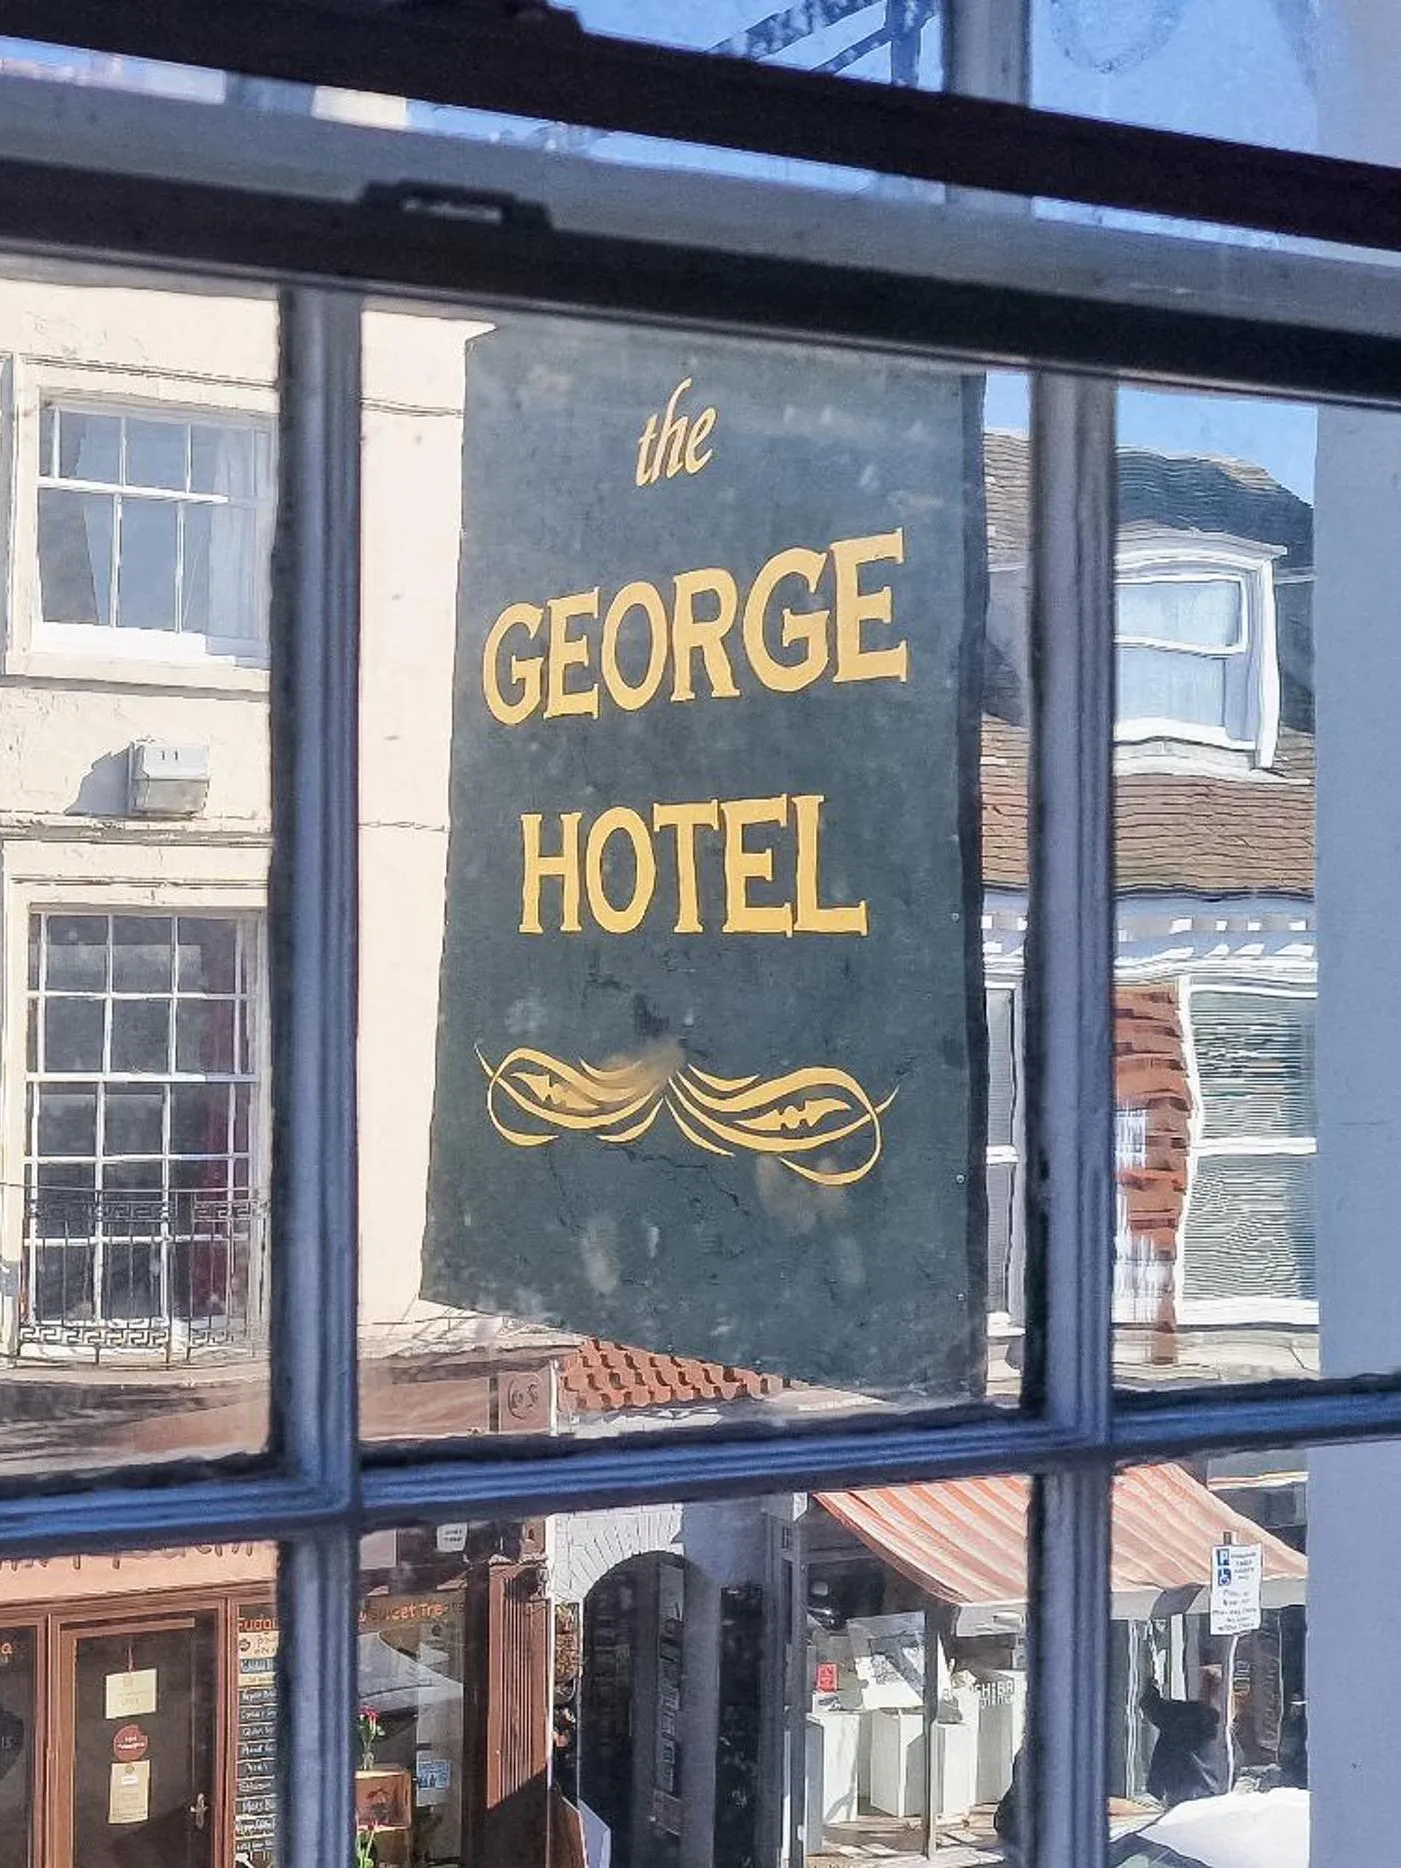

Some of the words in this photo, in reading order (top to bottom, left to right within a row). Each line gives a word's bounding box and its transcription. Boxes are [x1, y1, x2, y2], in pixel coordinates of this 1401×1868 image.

[635, 375, 717, 487] the
[483, 528, 908, 725] GEORGE
[519, 794, 869, 937] HOTEL
